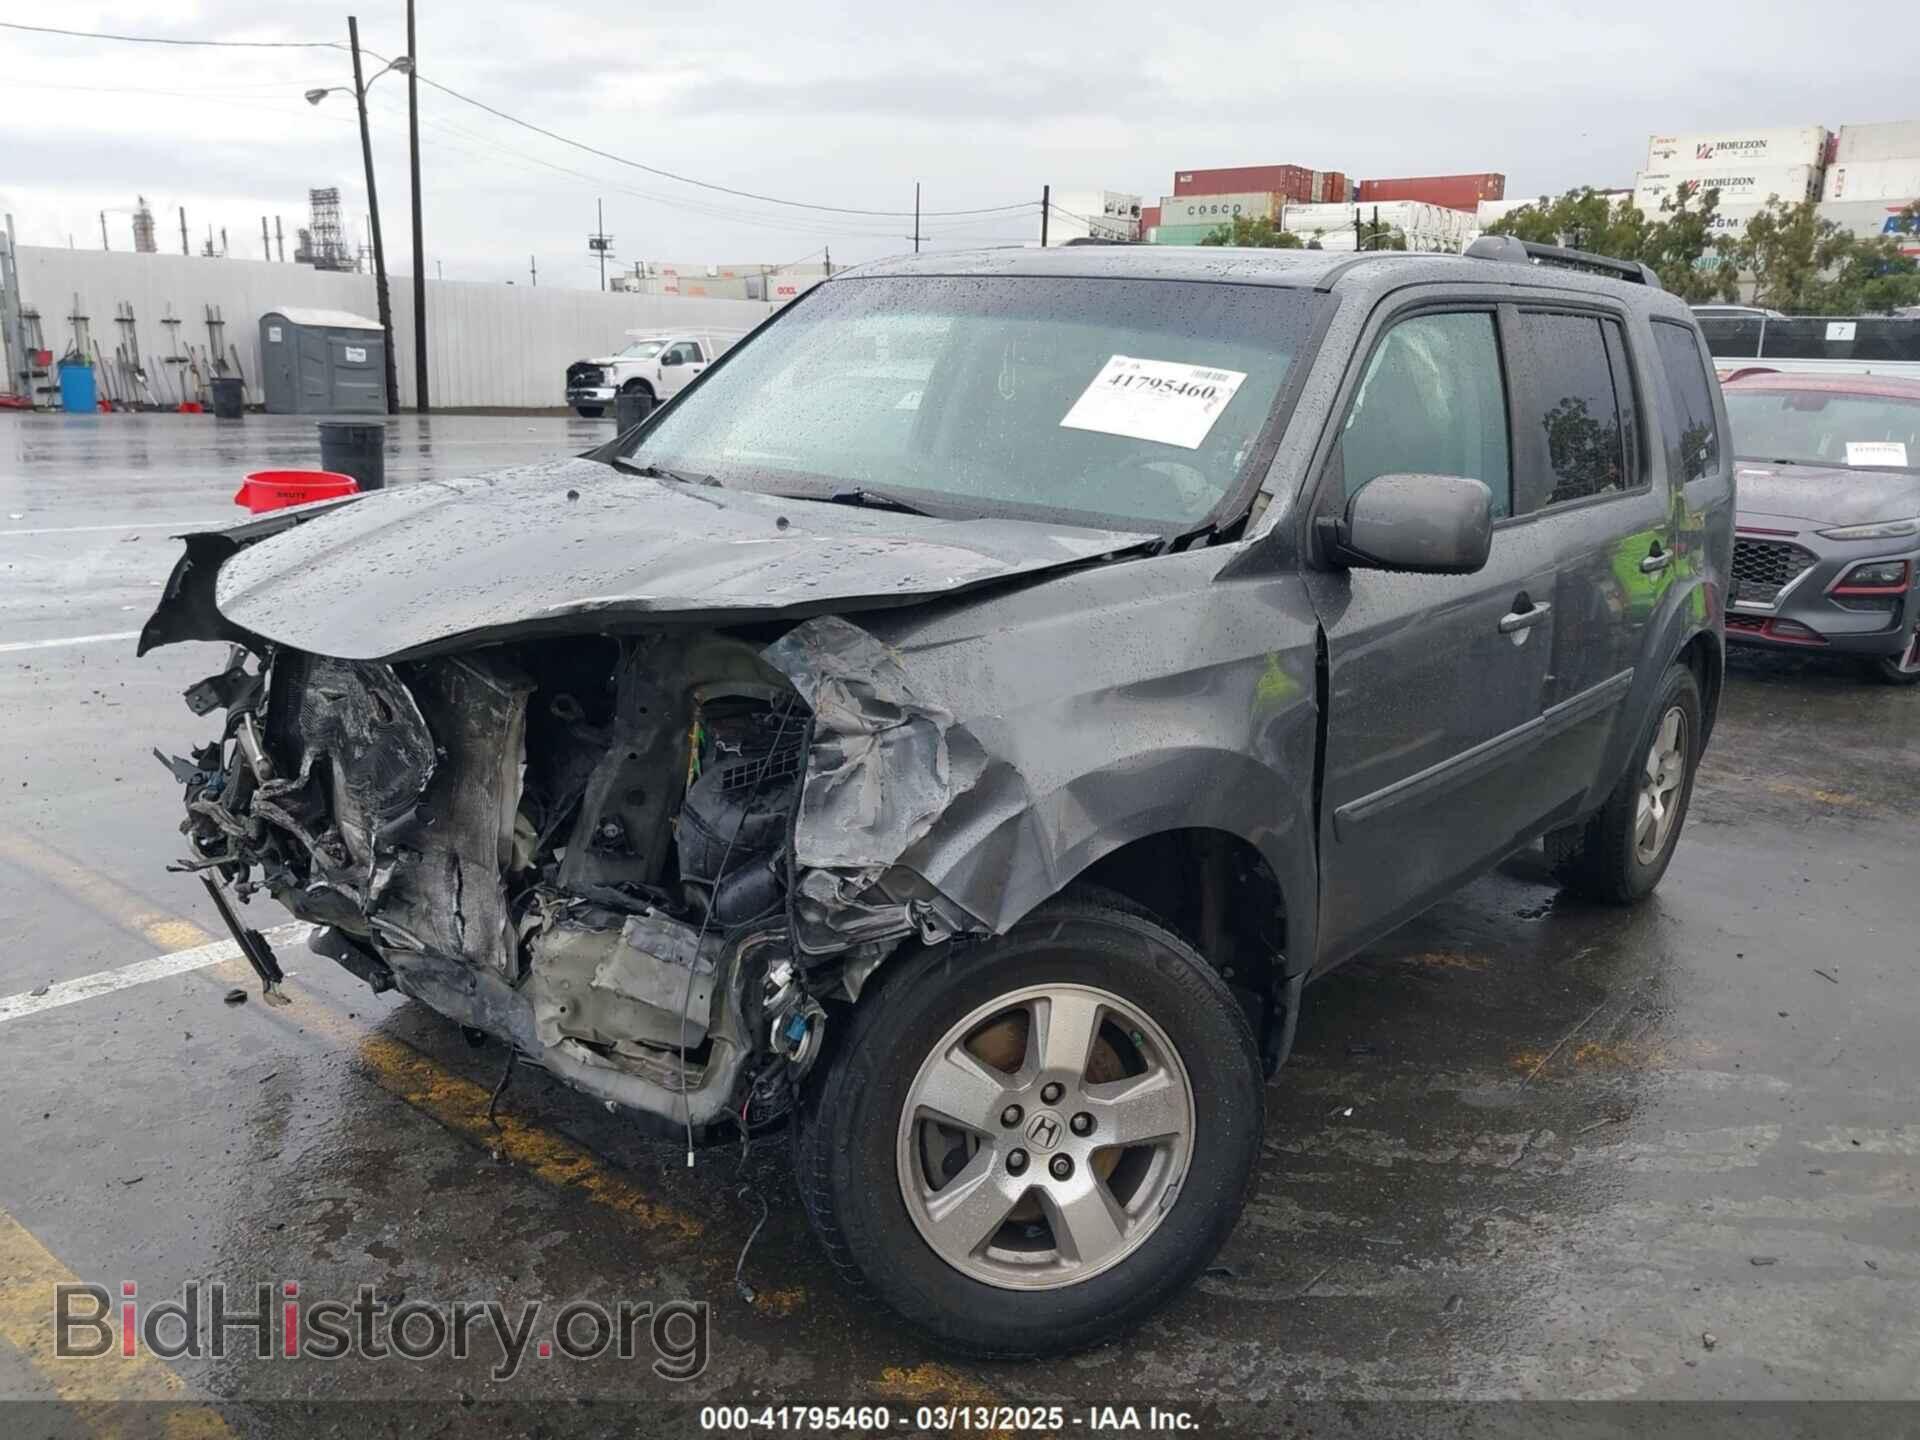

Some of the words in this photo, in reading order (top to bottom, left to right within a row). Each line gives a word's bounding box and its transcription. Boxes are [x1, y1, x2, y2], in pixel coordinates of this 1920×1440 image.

[1716, 139, 1768, 150] HORIZON
[1703, 177, 1756, 187] HORIZON
[1187, 203, 1242, 216] COSCO
[1108, 373, 1217, 399] 41795460
